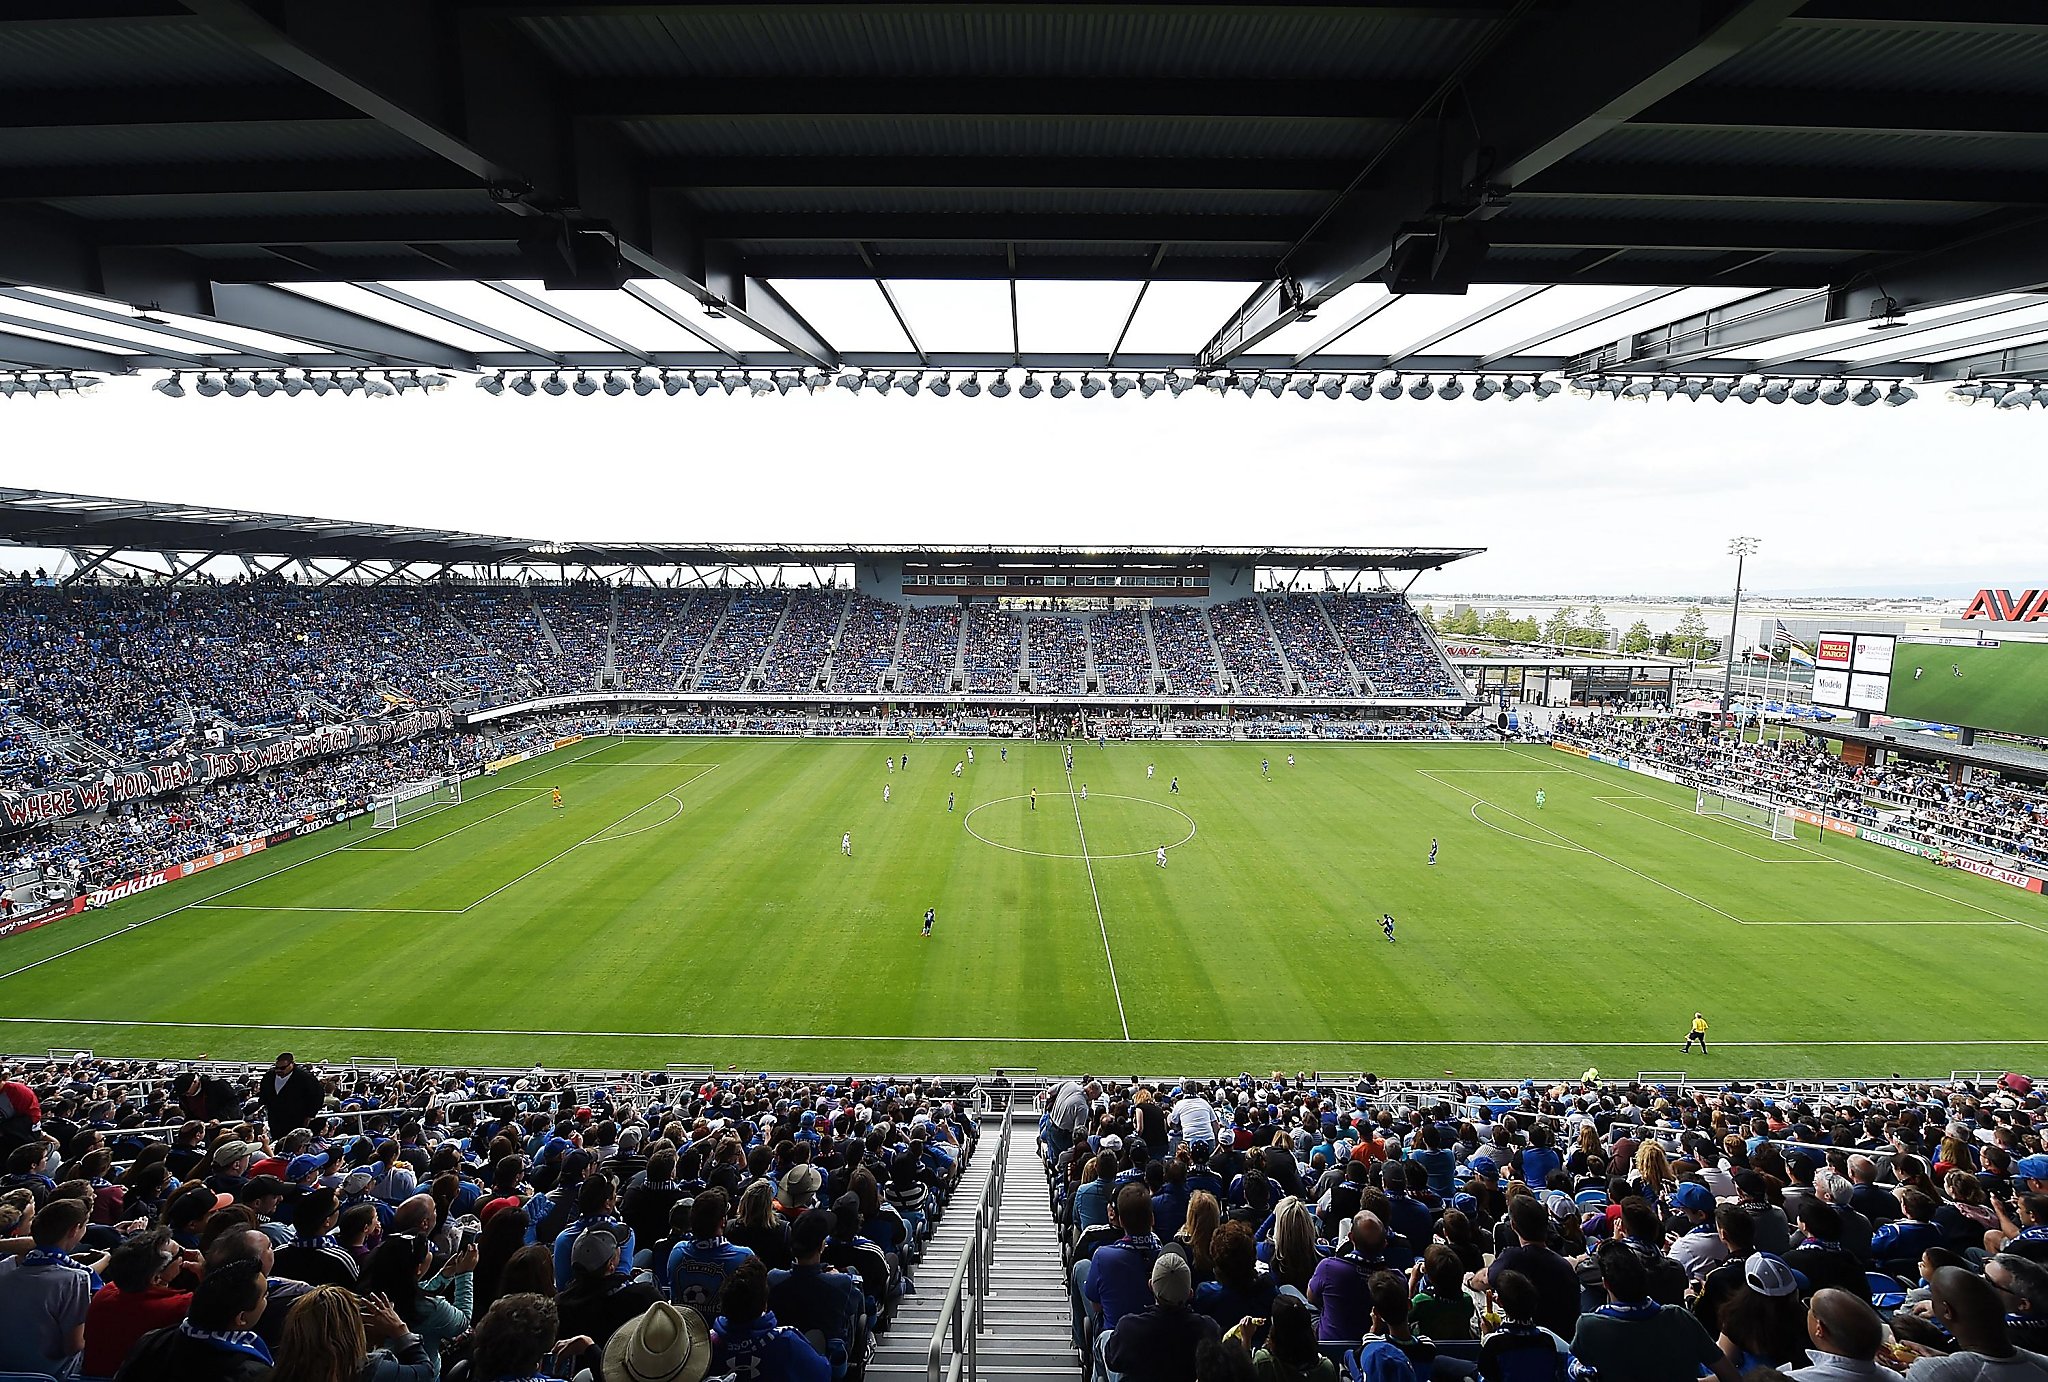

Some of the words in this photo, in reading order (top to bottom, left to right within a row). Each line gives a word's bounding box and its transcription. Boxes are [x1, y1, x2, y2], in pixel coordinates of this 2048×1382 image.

[1822, 643, 1848, 652] WELLS
[1822, 650, 1847, 658] FARGO
[1819, 679, 1842, 689] Modelo
[355, 724, 380, 745] THIS
[380, 723, 392, 743] IS
[390, 711, 421, 738] WHERE
[201, 753, 239, 779] THIS
[239, 750, 260, 773] IS
[257, 739, 299, 767] WHERE
[298, 736, 319, 757] WE
[462, 768, 480, 780] adidas
[398, 786, 433, 802] Heineken
[5, 789, 77, 826] WHERE
[77, 782, 108, 809] WE
[271, 832, 291, 844] Audi
[1862, 829, 1918, 856] Heineken
[1956, 858, 2028, 887] ADVOCARE
[28, 912, 48, 923] Power
